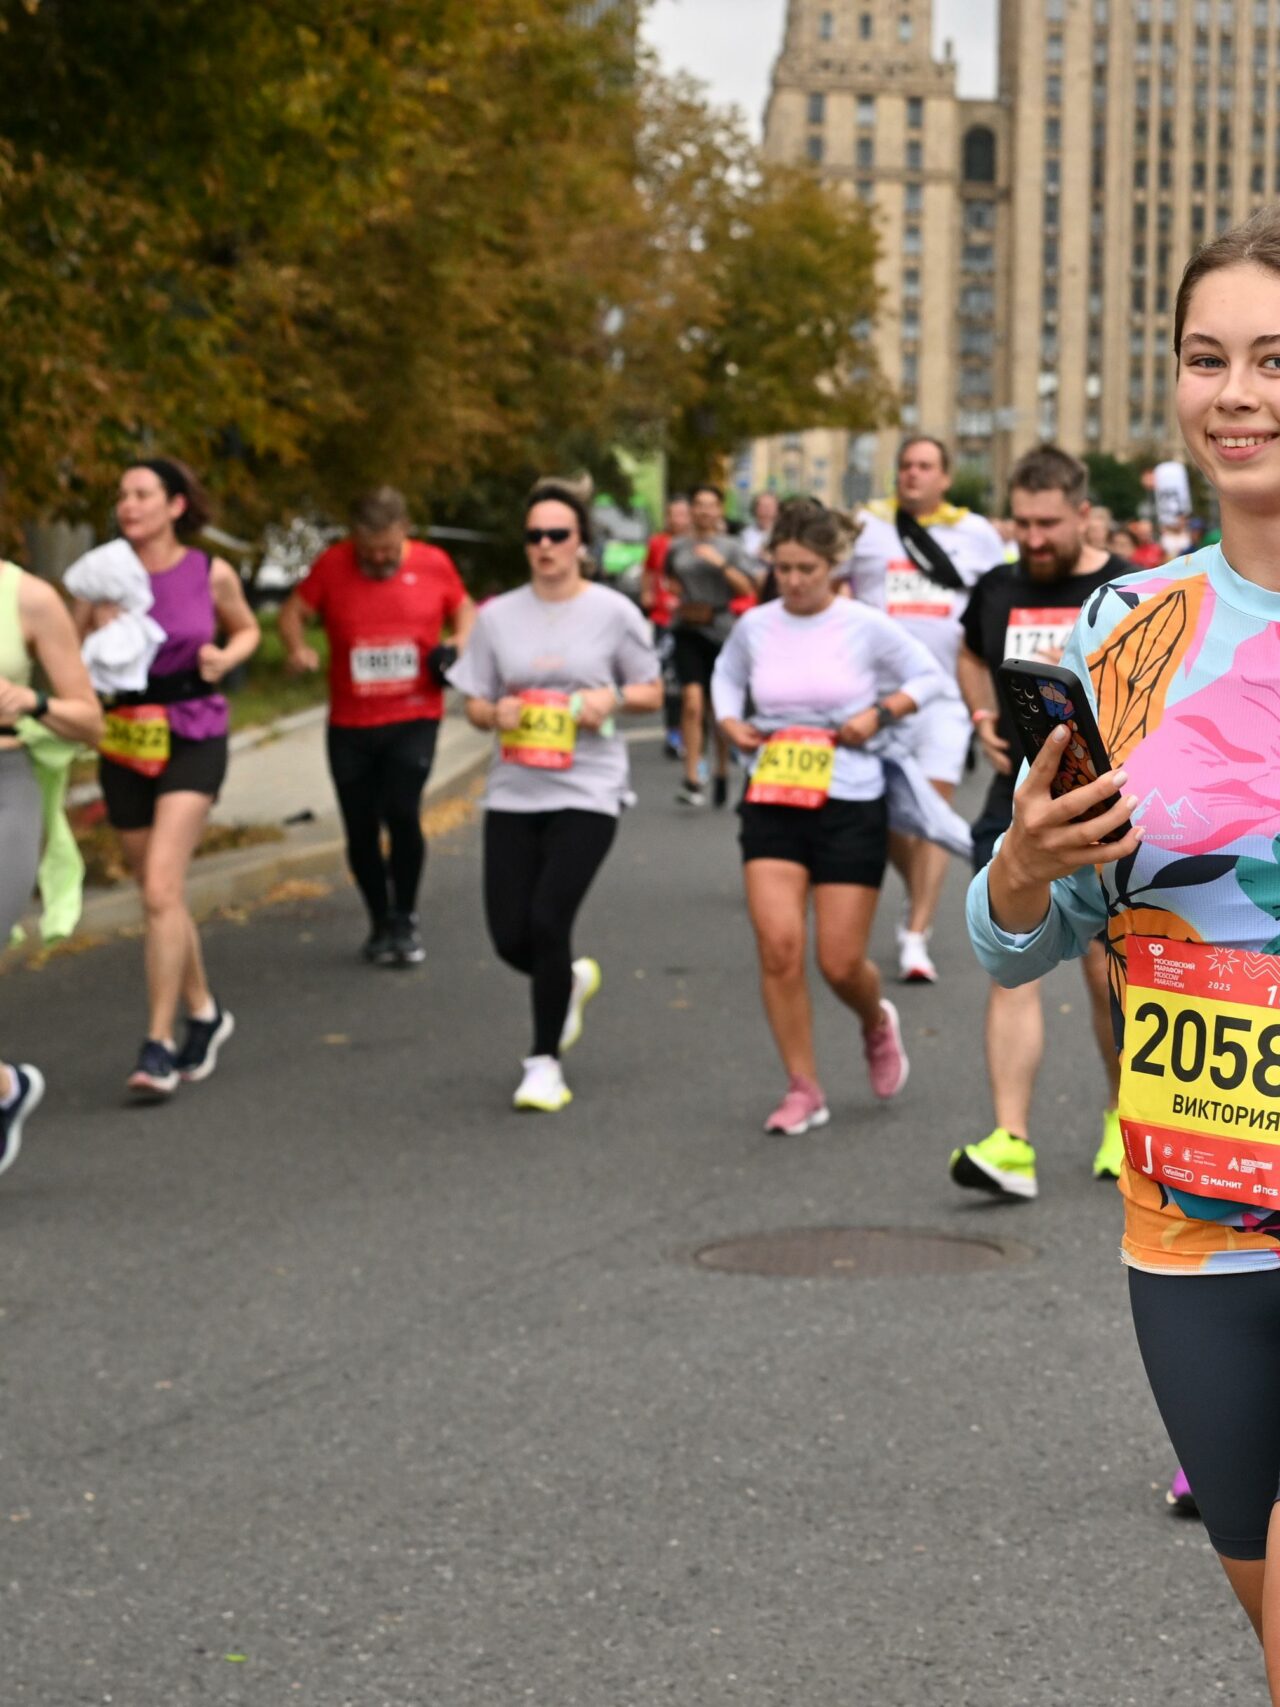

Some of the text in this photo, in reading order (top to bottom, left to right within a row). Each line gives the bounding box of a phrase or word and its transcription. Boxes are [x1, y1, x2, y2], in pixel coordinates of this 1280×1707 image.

[1153, 965, 1184, 975] МАРАФОН
[1153, 972, 1180, 980] MOSCOW
[1153, 978, 1185, 989] MARATHON
[1207, 981, 1231, 992] 2025
[1172, 1093, 1280, 1131] ВИКТОРИЯ
[1210, 1177, 1243, 1190] МАГНИТ
[1262, 1186, 1279, 1196] ПСБ
